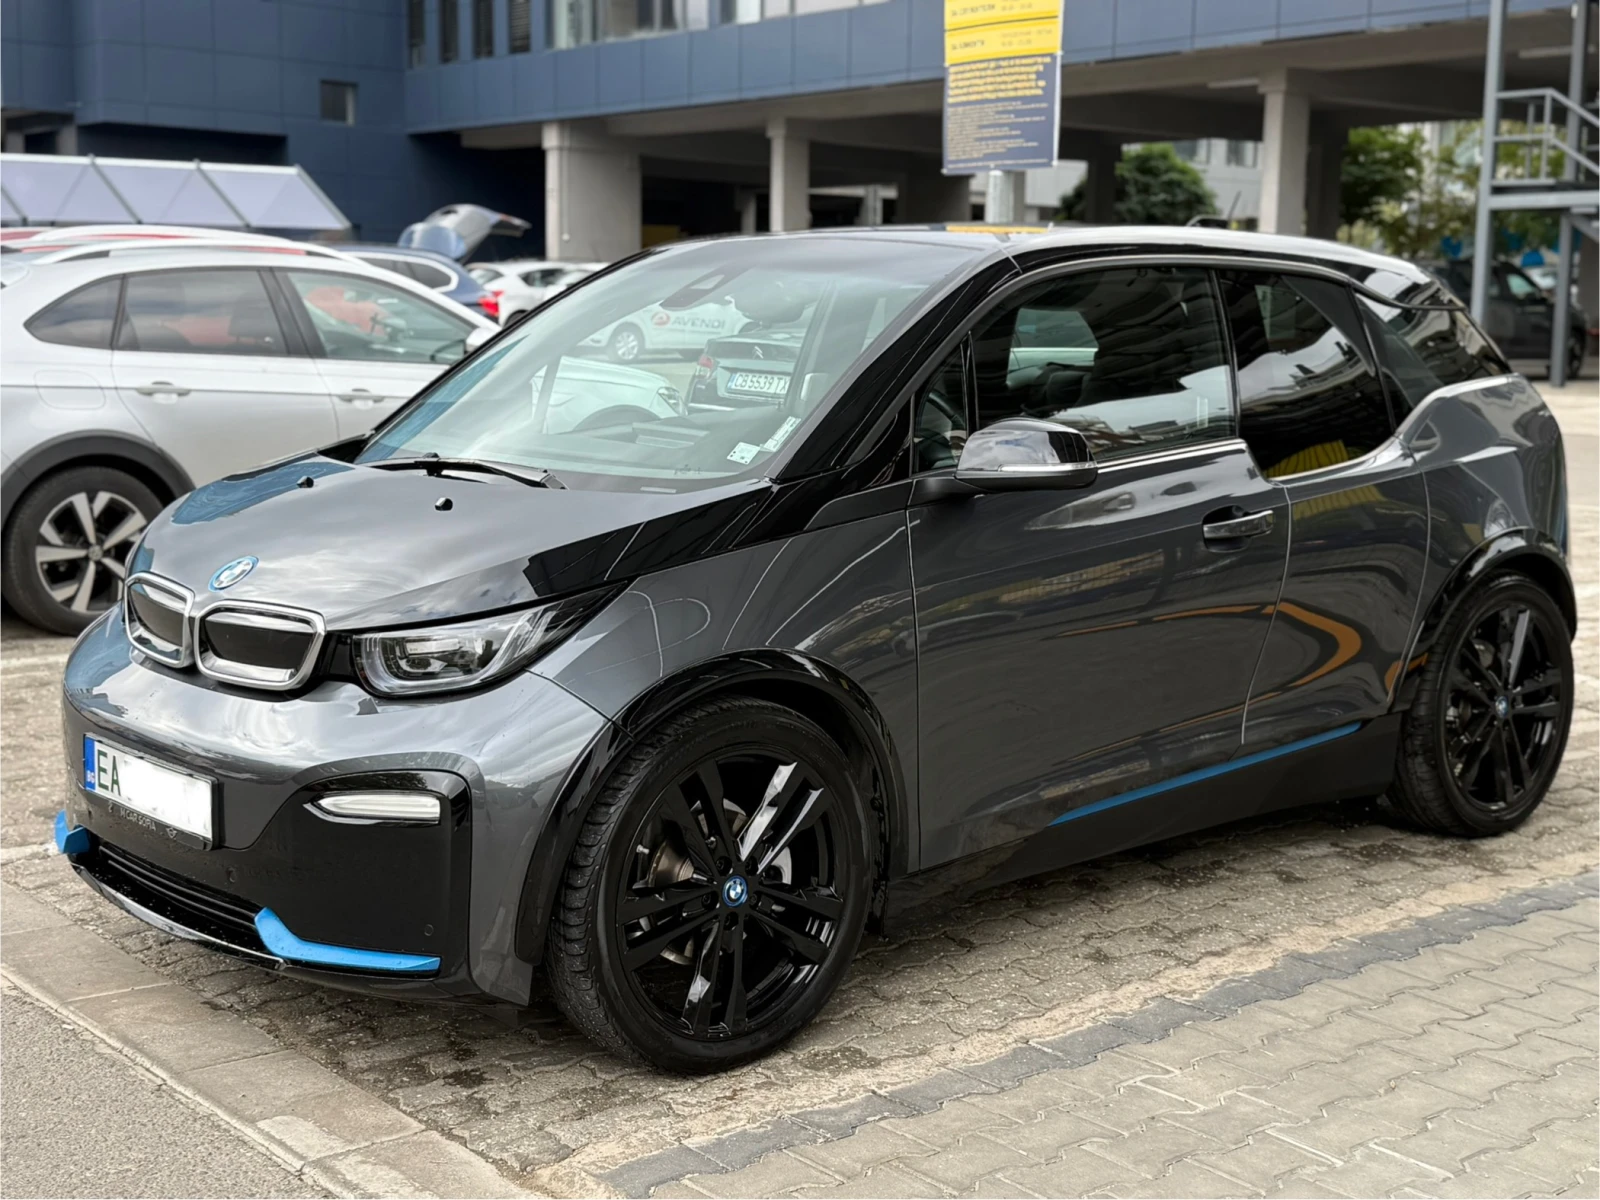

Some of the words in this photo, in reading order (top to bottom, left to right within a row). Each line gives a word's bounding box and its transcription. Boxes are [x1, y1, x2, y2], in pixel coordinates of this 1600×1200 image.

[672, 315, 726, 329] AVENDI
[748, 374, 774, 391] 5539
[97, 749, 121, 796] EA
